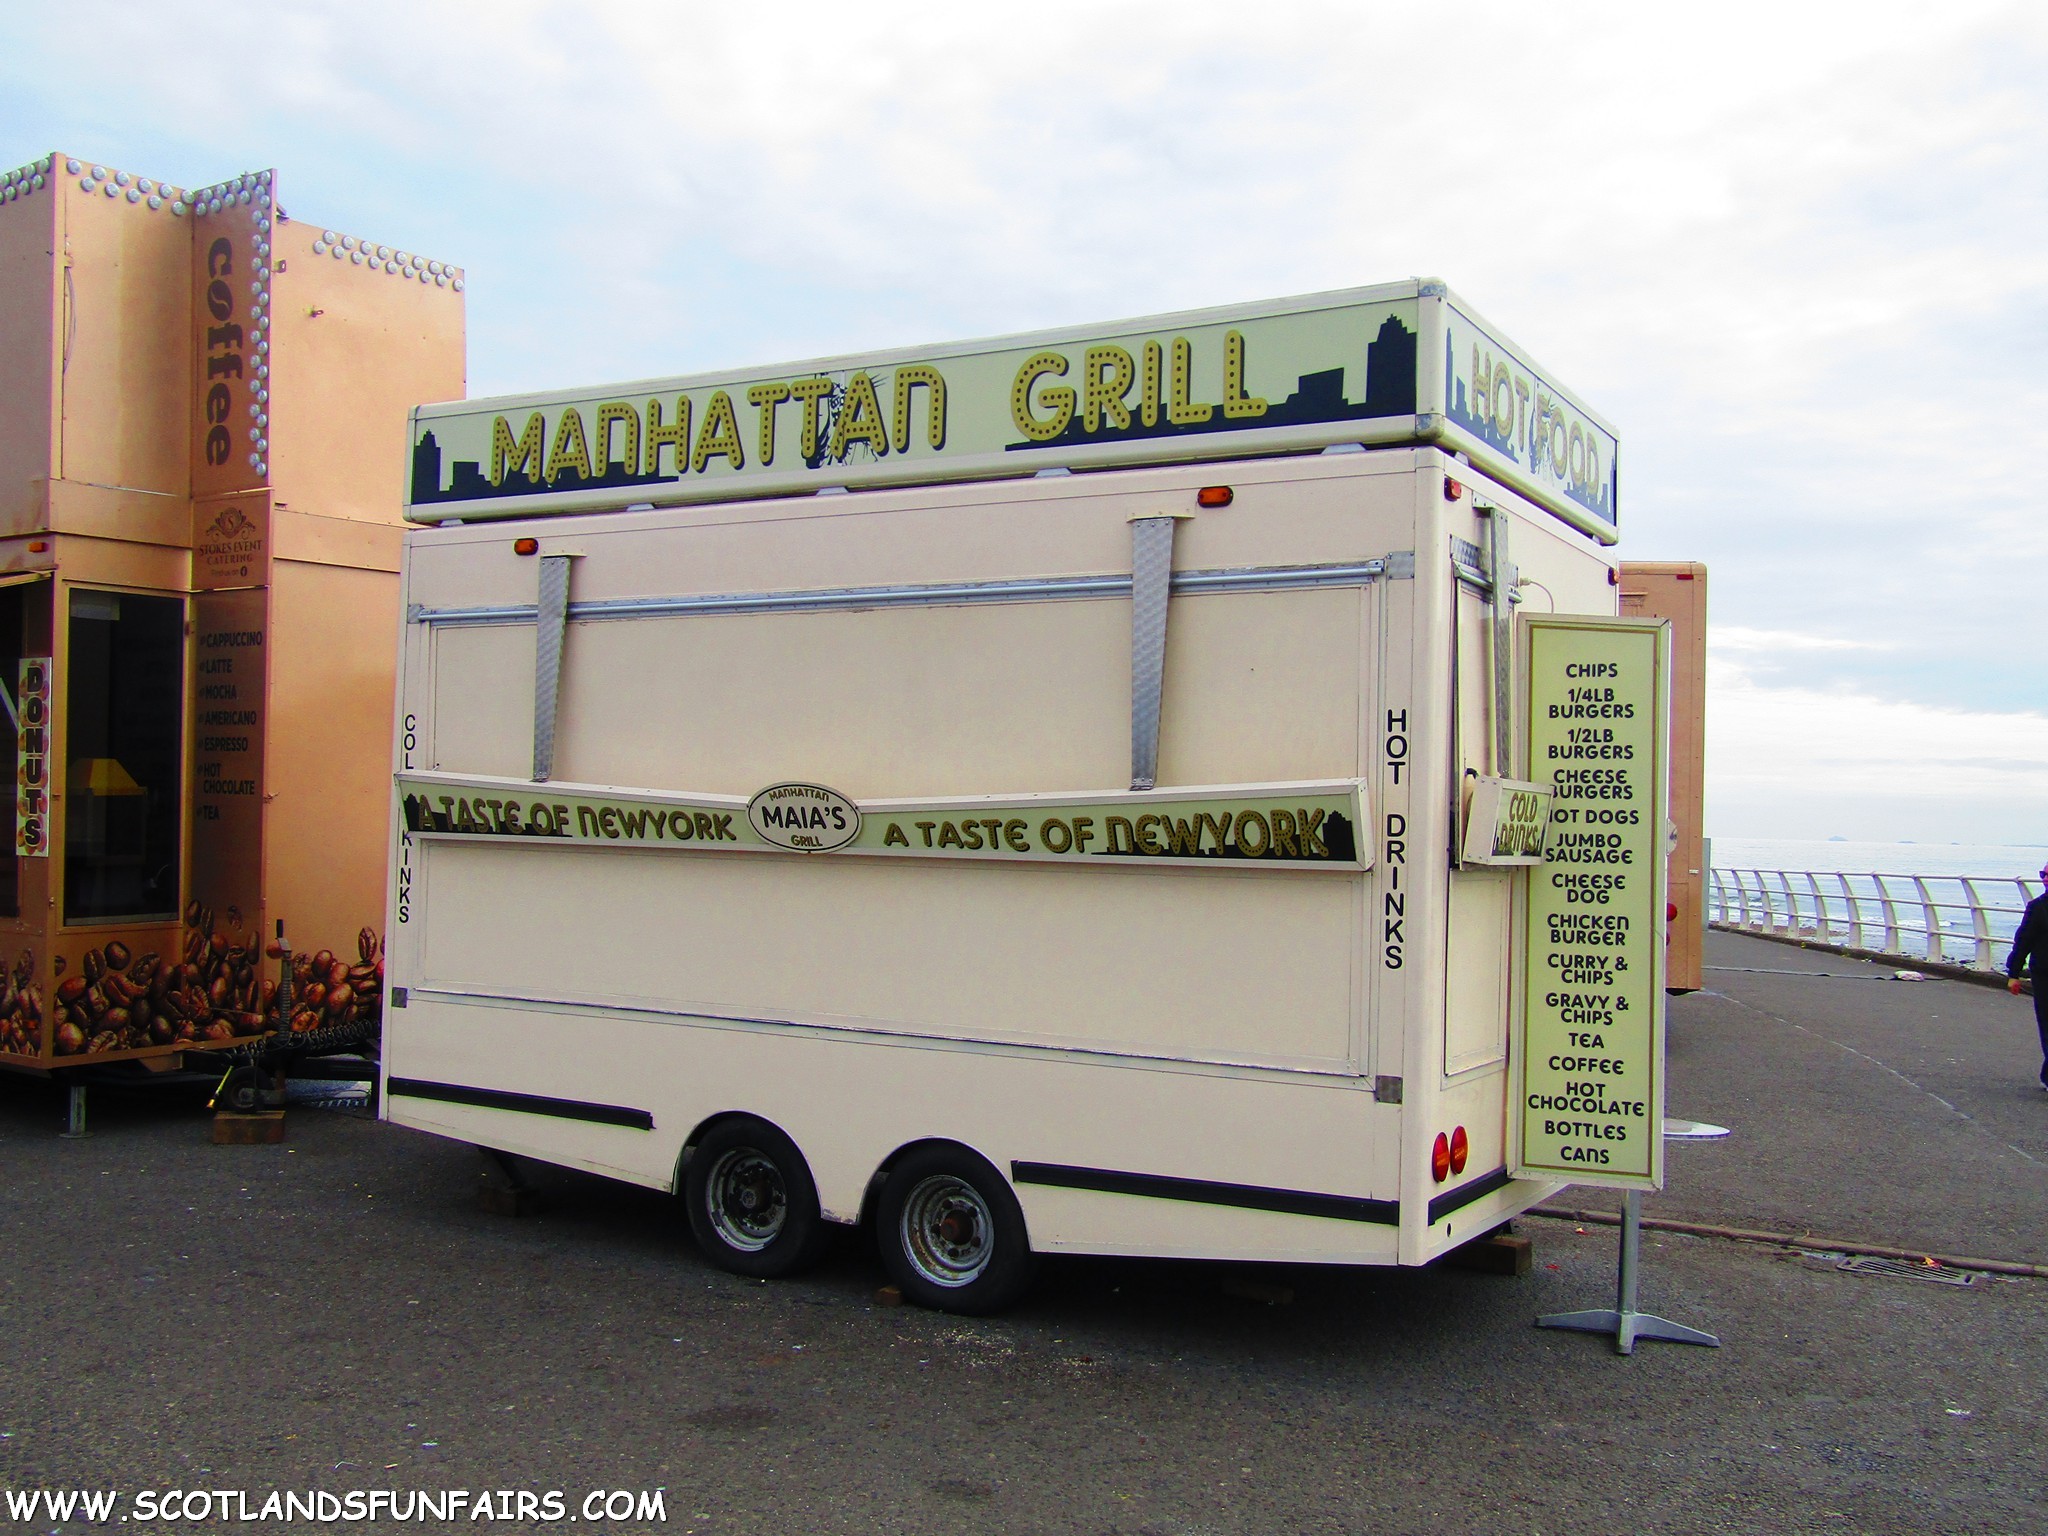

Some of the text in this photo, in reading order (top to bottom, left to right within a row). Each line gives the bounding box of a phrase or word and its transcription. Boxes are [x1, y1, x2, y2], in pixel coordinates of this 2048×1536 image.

[490, 329, 1267, 488] MANHATTAN GRILL
[1471, 342, 1600, 495] HOT FOOD
[199, 540, 262, 556] STOKES EVENT
[207, 554, 252, 565] CATERING
[206, 631, 262, 648] CAPPUCCINO
[205, 658, 232, 673] LATTE
[1565, 663, 1618, 678] CHIPS
[205, 685, 237, 699] MOCHA
[1567, 688, 1615, 703] 1/4LB
[205, 711, 256, 726] AMERICANO
[1548, 704, 1634, 719] BURGERS
[403, 714, 416, 770] COL
[1567, 729, 1614, 743] 1/2LB
[204, 737, 248, 752] ESPRESSO
[1548, 745, 1634, 760] BURGERS
[25, 666, 45, 847] DONUTS
[203, 763, 222, 778] HOT
[1553, 769, 1627, 784] CHEESE
[203, 779, 255, 795] CHOCOLATE
[768, 788, 830, 802] MANHATTAN
[203, 805, 220, 820] TEA
[418, 794, 436, 831] A
[439, 795, 524, 834] TASTE
[530, 803, 569, 836] OF
[1509, 792, 1538, 822] COLD
[761, 806, 847, 830] MAIA'S
[1585, 809, 1639, 825] DOGS
[790, 834, 823, 847] GRILL
[883, 822, 909, 848] A
[915, 818, 1029, 852] TASTE
[1040, 817, 1094, 854] OF
[1385, 708, 1408, 970] HOT DRINKS
[1500, 823, 1538, 852] DRINKS
[1556, 833, 1622, 849] JUMBO
[1545, 849, 1633, 864] SAUSAGE
[1551, 873, 1626, 889] CHEESE
[1567, 889, 1610, 904] DOG
[1547, 913, 1629, 931] CHICKEN
[1550, 929, 1625, 946] BURGER
[1547, 953, 1628, 971] CURRY &
[1561, 969, 1613, 985] CHIPS
[1545, 992, 1629, 1011] GRAVY &
[1561, 1009, 1613, 1025] CHIPS
[1568, 1032, 1605, 1048] TEA
[1549, 1055, 1624, 1075] COFFEE
[1566, 1082, 1606, 1097] HOT
[1528, 1095, 1645, 1116] CHOCOLATE
[1545, 1120, 1626, 1140] BOTTLES
[1560, 1146, 1610, 1164] CANS
